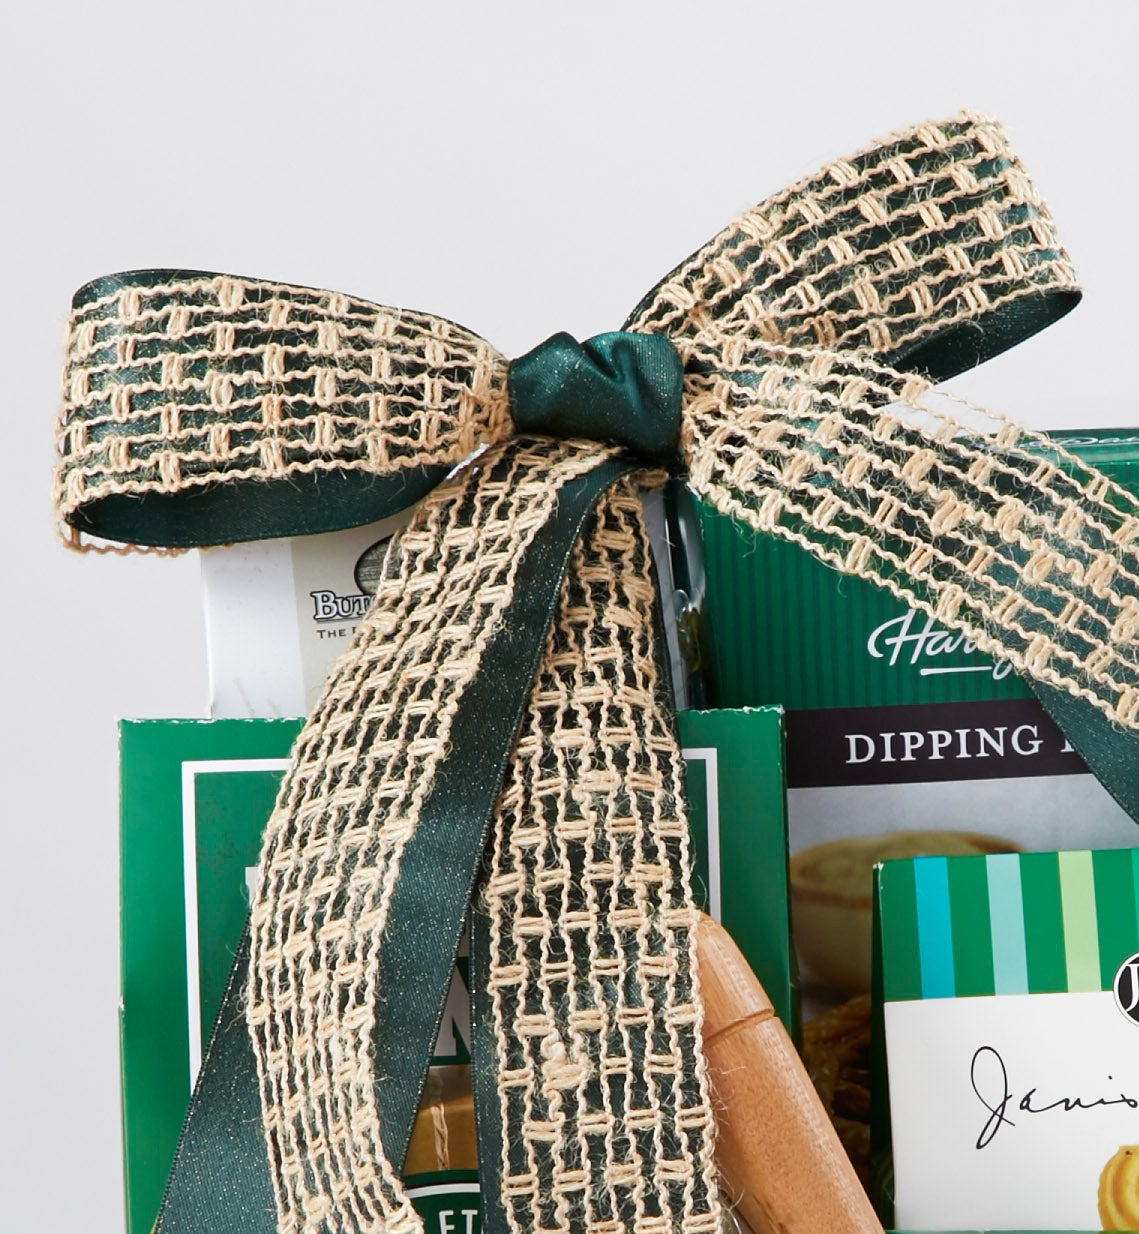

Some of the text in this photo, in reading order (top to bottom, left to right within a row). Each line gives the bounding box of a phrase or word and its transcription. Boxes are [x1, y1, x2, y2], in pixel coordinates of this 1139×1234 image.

[310, 590, 375, 621] BUT
[317, 629, 346, 639] THE
[845, 725, 1044, 764] DIPPING
